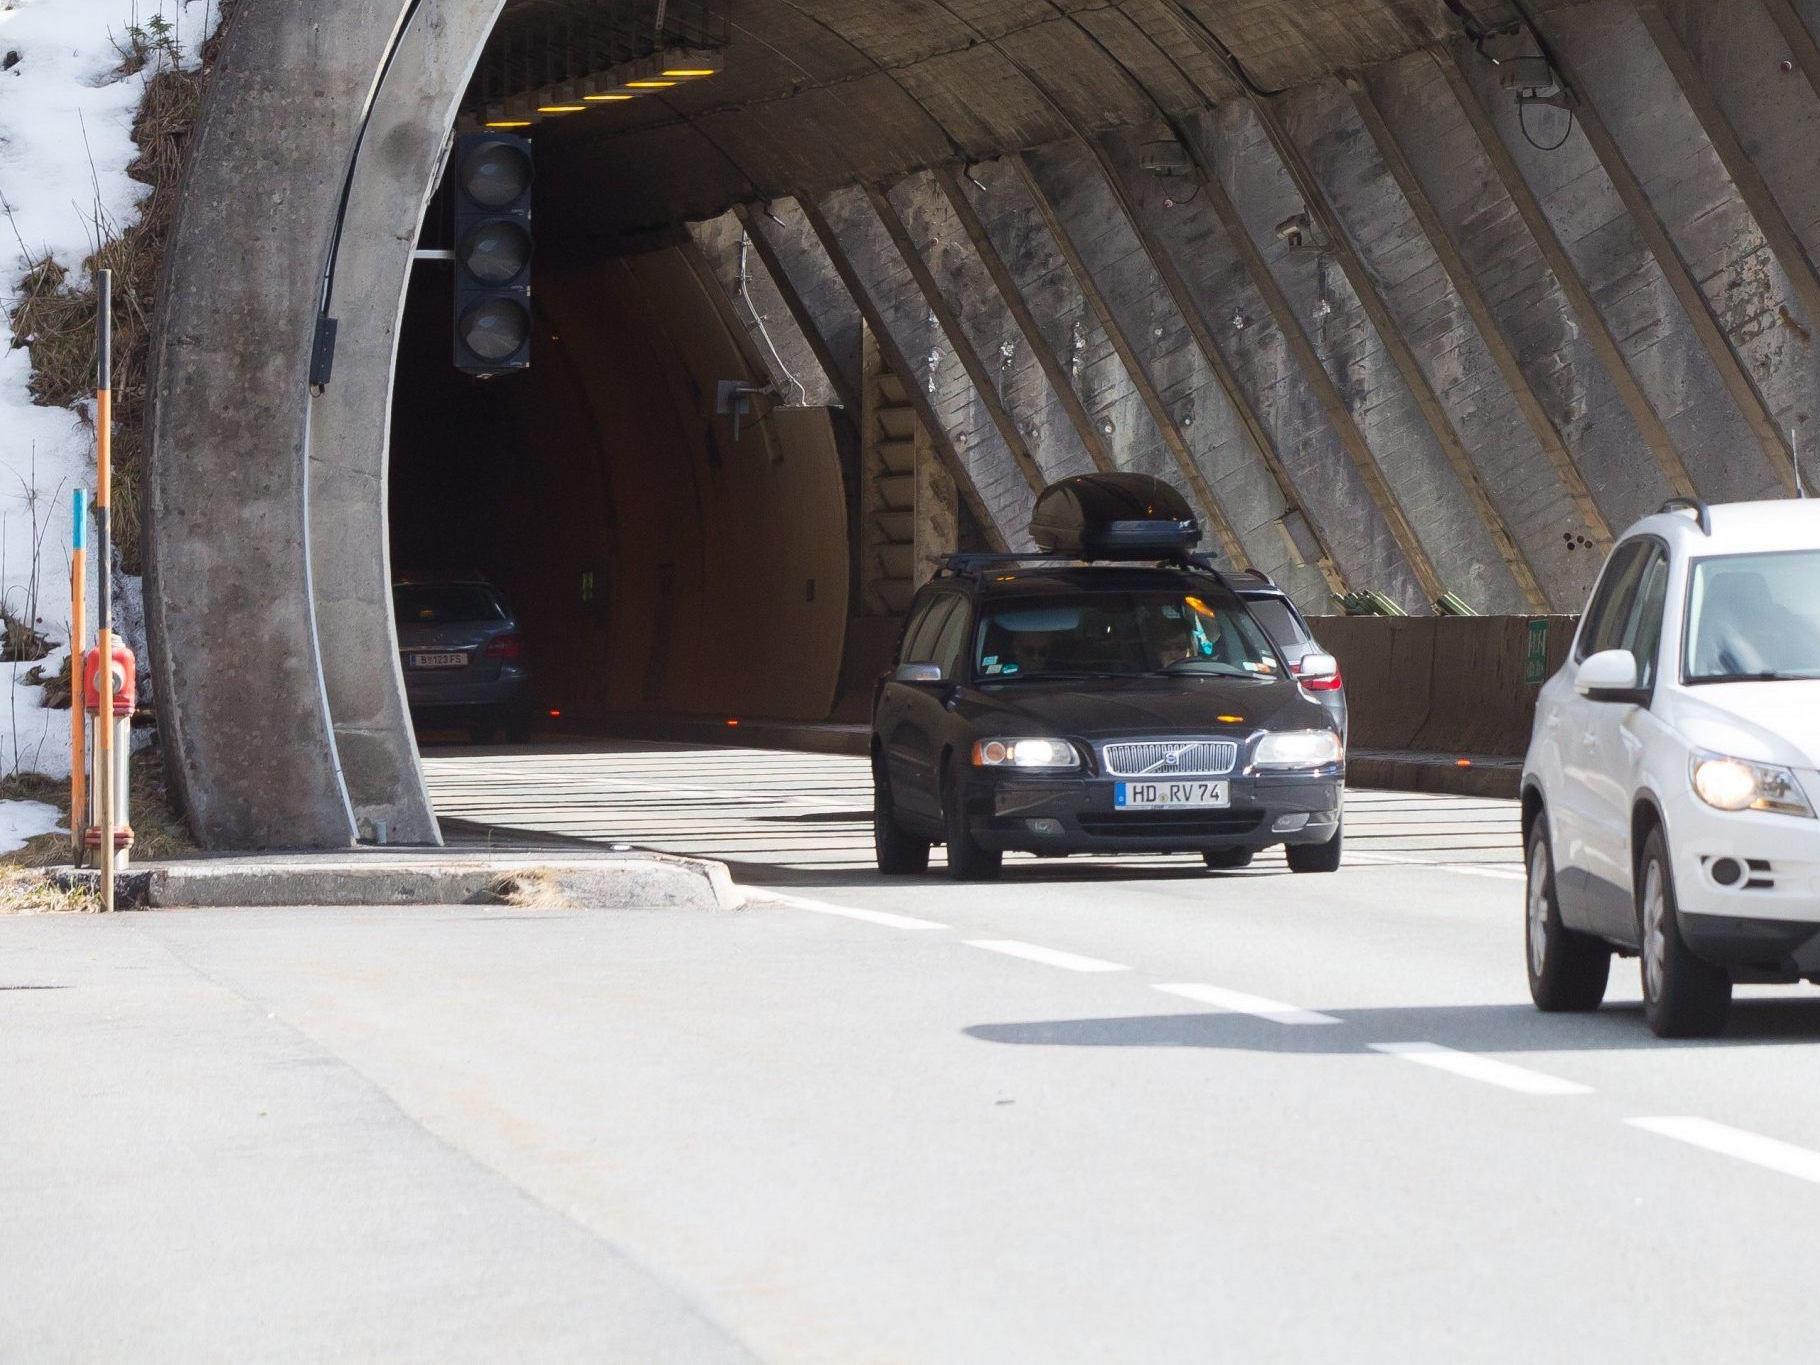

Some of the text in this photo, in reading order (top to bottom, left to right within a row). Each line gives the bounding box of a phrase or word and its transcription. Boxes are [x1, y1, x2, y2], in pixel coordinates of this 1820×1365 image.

[1132, 783, 1220, 803] HD RV 74
